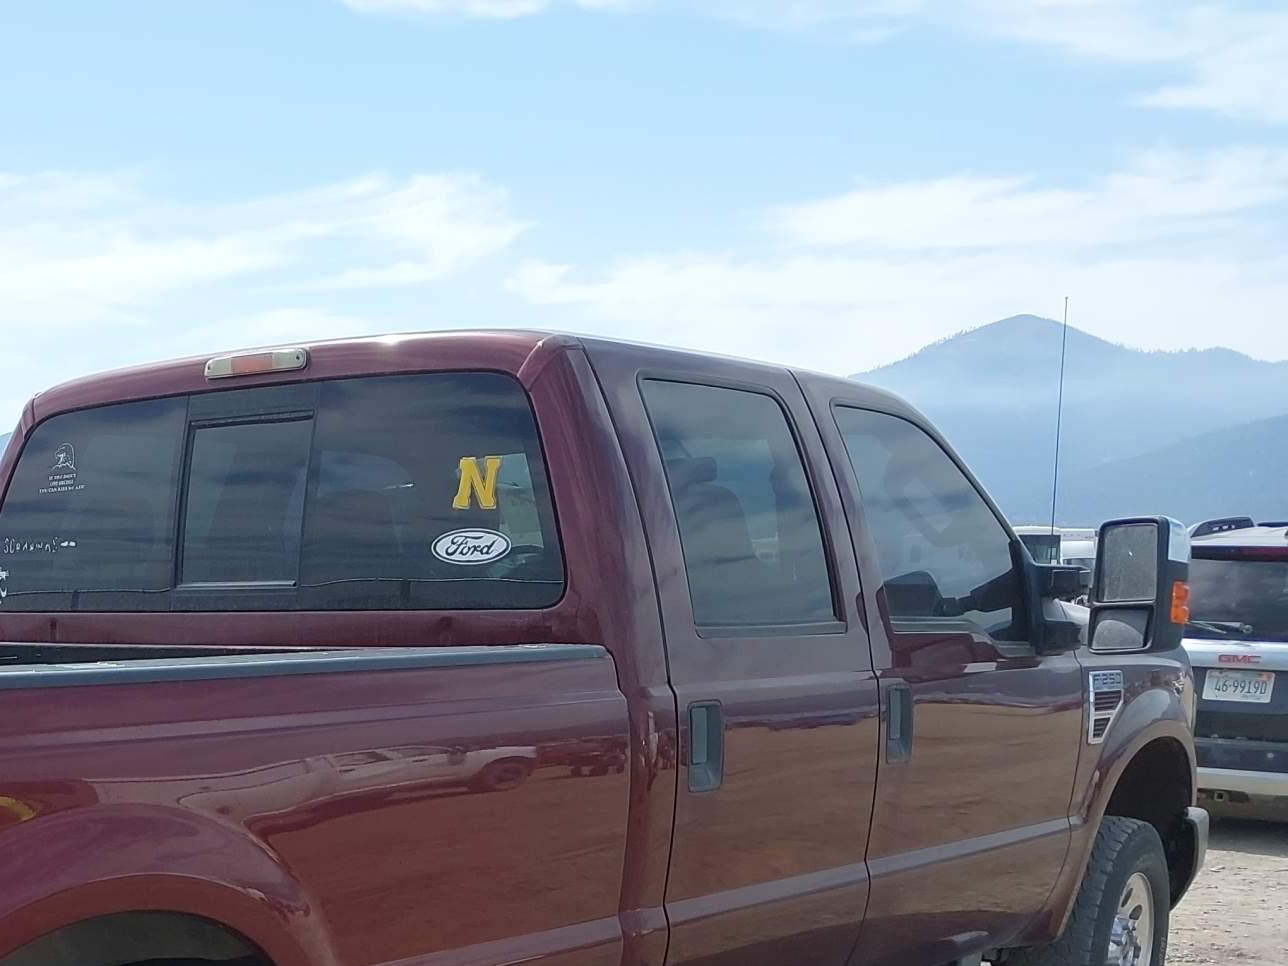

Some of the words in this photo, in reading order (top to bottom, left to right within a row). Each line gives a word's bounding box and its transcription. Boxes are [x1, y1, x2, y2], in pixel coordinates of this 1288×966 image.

[452, 456, 501, 509] N
[445, 535, 498, 556] Ford
[1218, 655, 1261, 664] GMC
